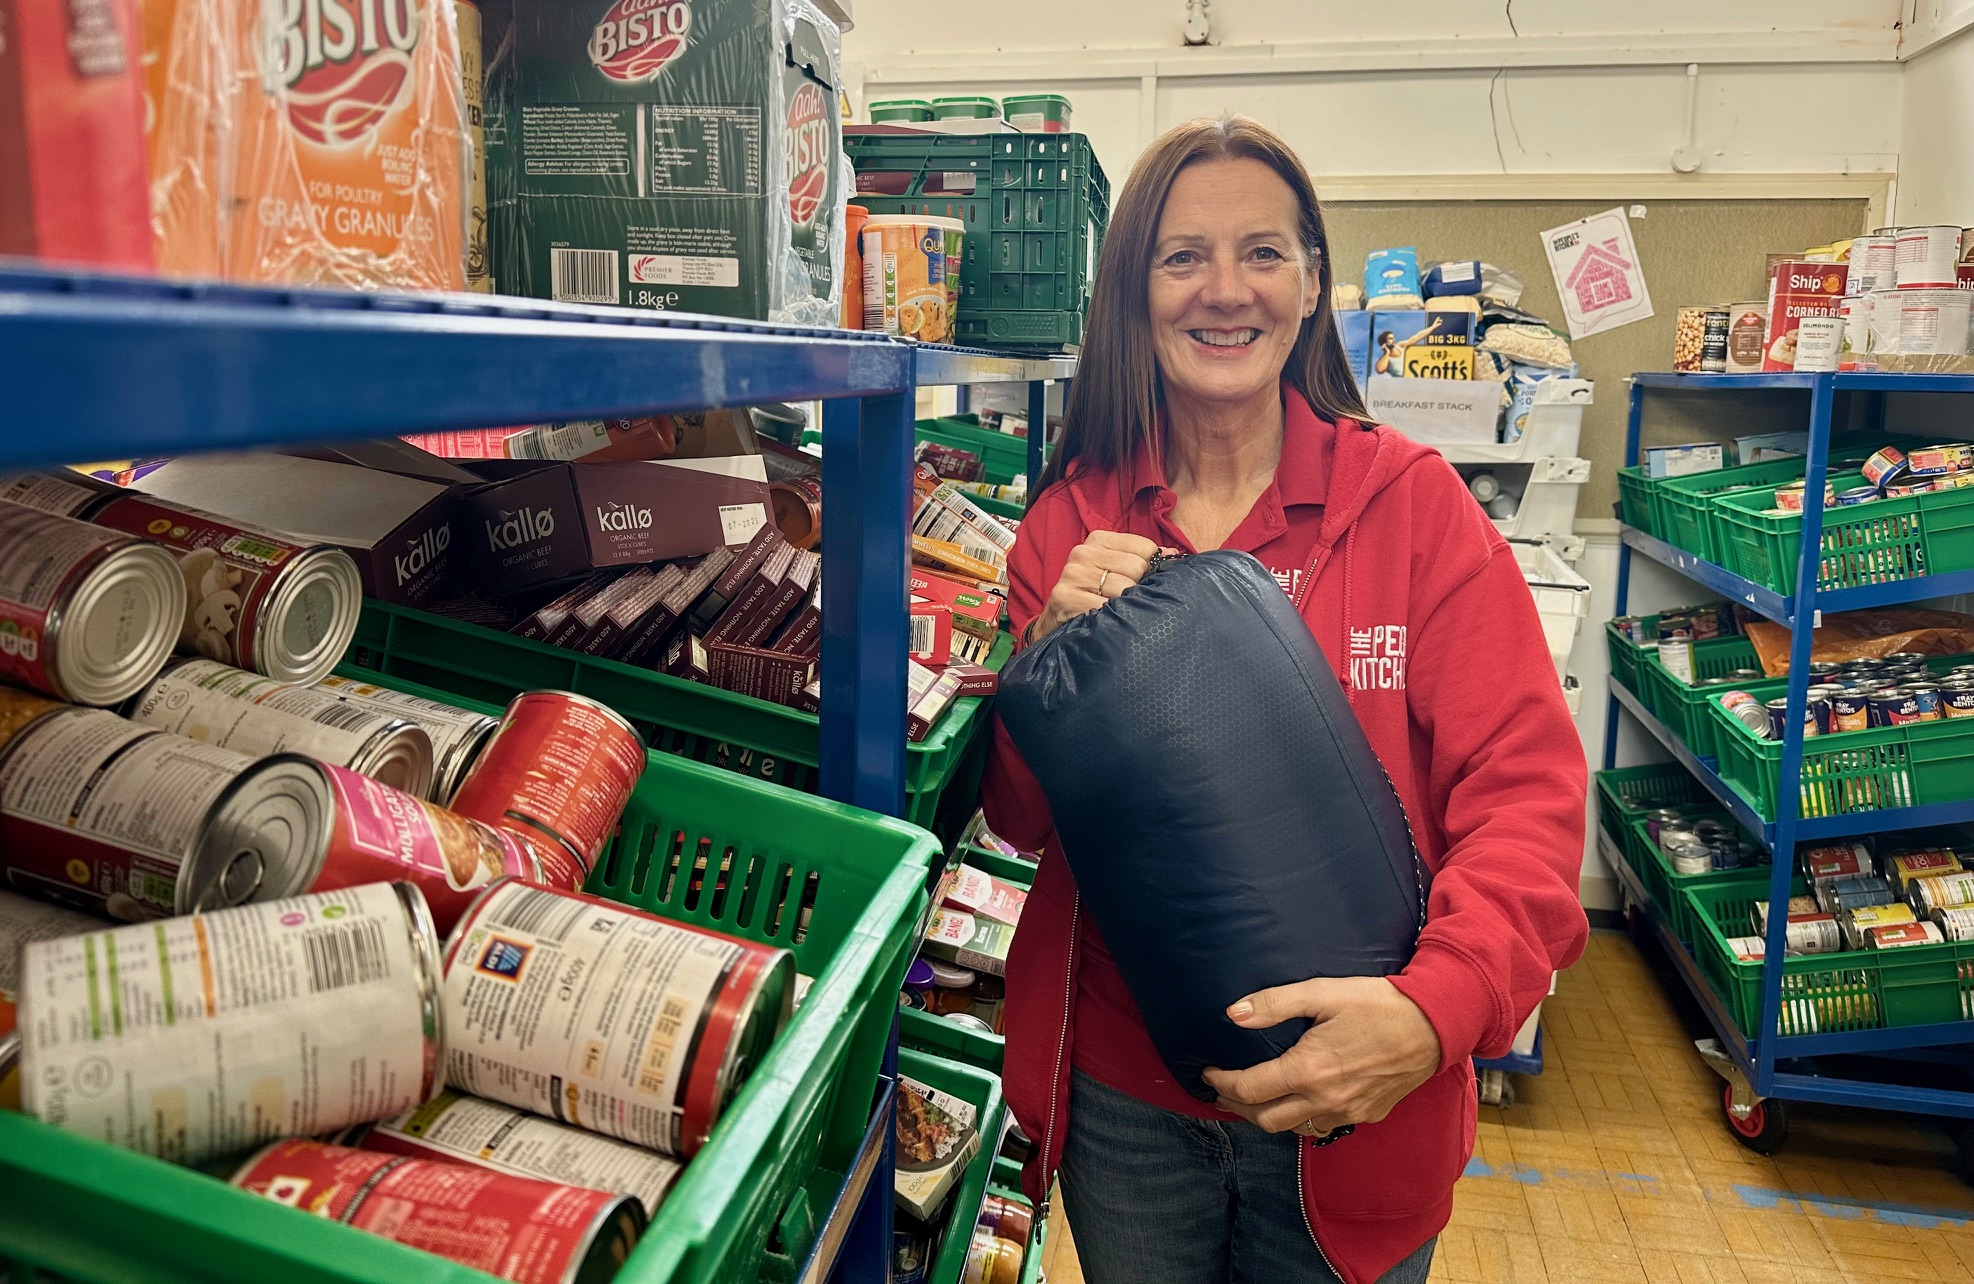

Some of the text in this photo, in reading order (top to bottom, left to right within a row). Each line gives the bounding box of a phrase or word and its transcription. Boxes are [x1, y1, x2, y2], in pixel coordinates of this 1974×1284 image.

[594, 3, 690, 64] BISTO
[795, 84, 820, 121] aah!
[786, 118, 829, 188] BISTO
[310, 181, 383, 204] FOR POULTRY
[258, 197, 330, 231] GRAVY
[806, 262, 830, 281] RANULES
[1790, 274, 1821, 292] Ship
[628, 290, 664, 310] 1.8kg
[1786, 306, 1827, 318] CORNED
[1428, 334, 1466, 344] BIG 3KG
[1408, 359, 1467, 380] Scott's
[1373, 400, 1472, 411] BREAKFAST STACK
[610, 533, 637, 542] ORGANIC
[502, 545, 552, 567] ORGANIC BEEF
[725, 530, 774, 592] ADD TASTE, NOTHING ELSE
[913, 538, 934, 552] MWELLS
[938, 550, 966, 563] CHICKEN
[530, 560, 548, 570] CUBES
[407, 568, 434, 596] ORGANIC
[957, 594, 981, 606] Knorr
[655, 612, 666, 625] ADD
[720, 583, 766, 640] ADD TASTE, NOTHING
[750, 588, 794, 643] ADD TASTE, NOTHING
[525, 626, 536, 637] ADD
[566, 624, 576, 637] ADD
[600, 625, 611, 638] ADD
[795, 616, 818, 644] ADD TASTE,
[1350, 626, 1371, 655] THE
[1350, 658, 1406, 690] KITCH
[142, 696, 163, 718] 400g
[803, 701, 817, 712] ELSE
[908, 722, 918, 735] ELSE
[380, 783, 414, 864] MULLIGAT
[963, 875, 980, 899] BANG!
[945, 916, 964, 939] BANG!
[486, 942, 504, 970] ALDI
[561, 958, 584, 986] 400g
